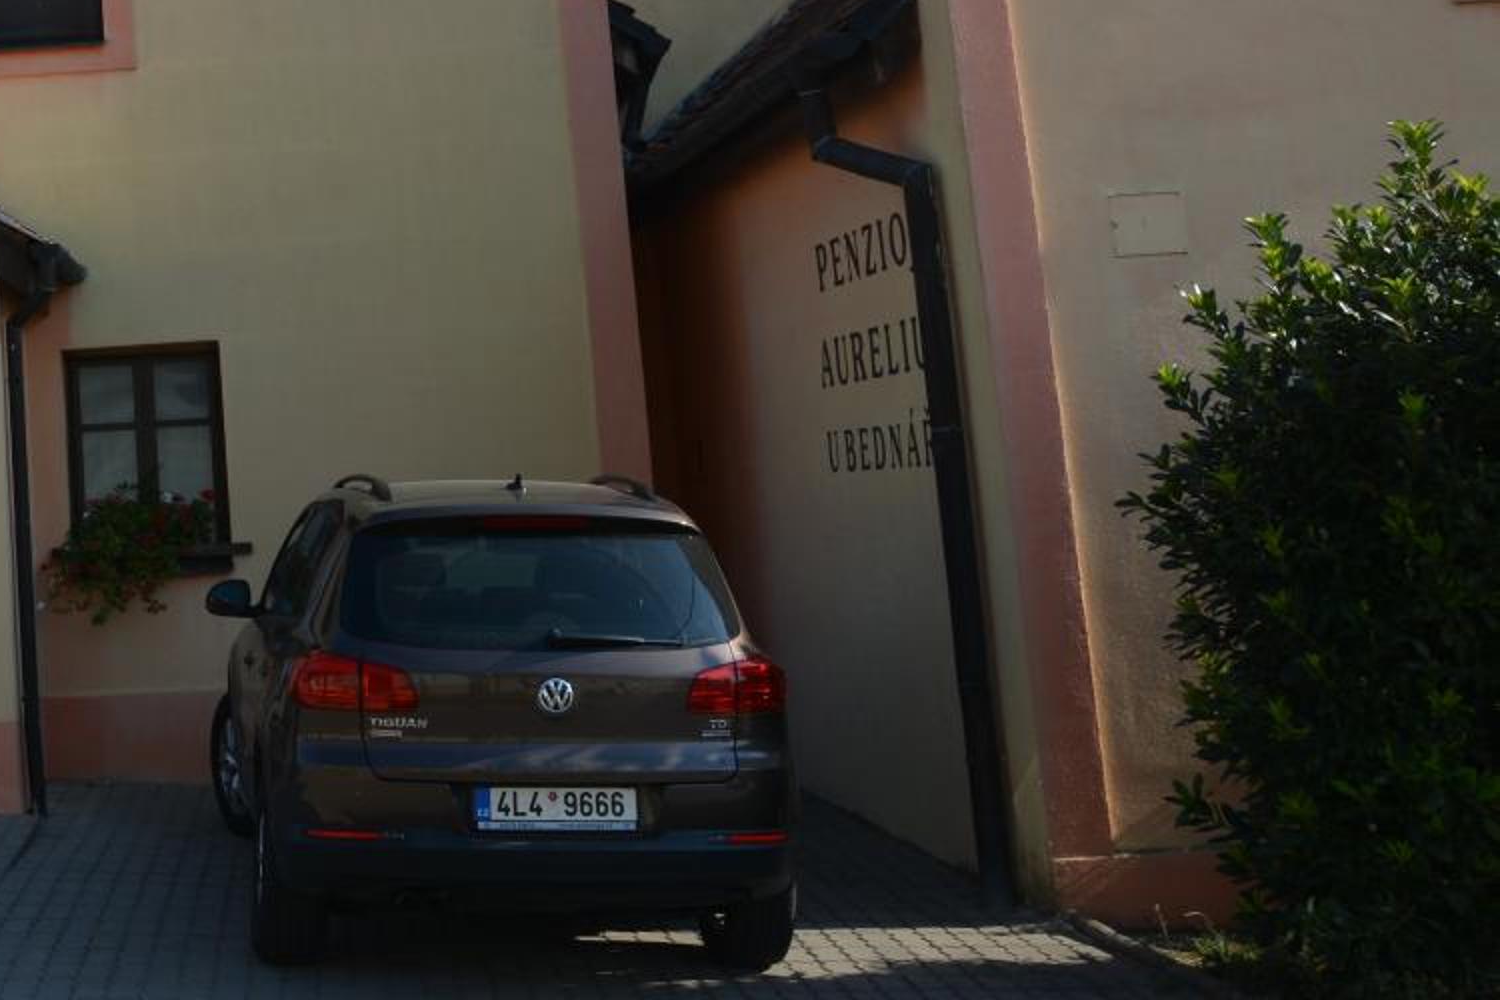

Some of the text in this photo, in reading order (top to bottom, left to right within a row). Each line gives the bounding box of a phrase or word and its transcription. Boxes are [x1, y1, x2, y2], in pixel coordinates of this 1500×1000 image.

[814, 212, 914, 292] PENZIO
[821, 315, 926, 389] AURELIU
[497, 791, 625, 817] 4L4 9666
